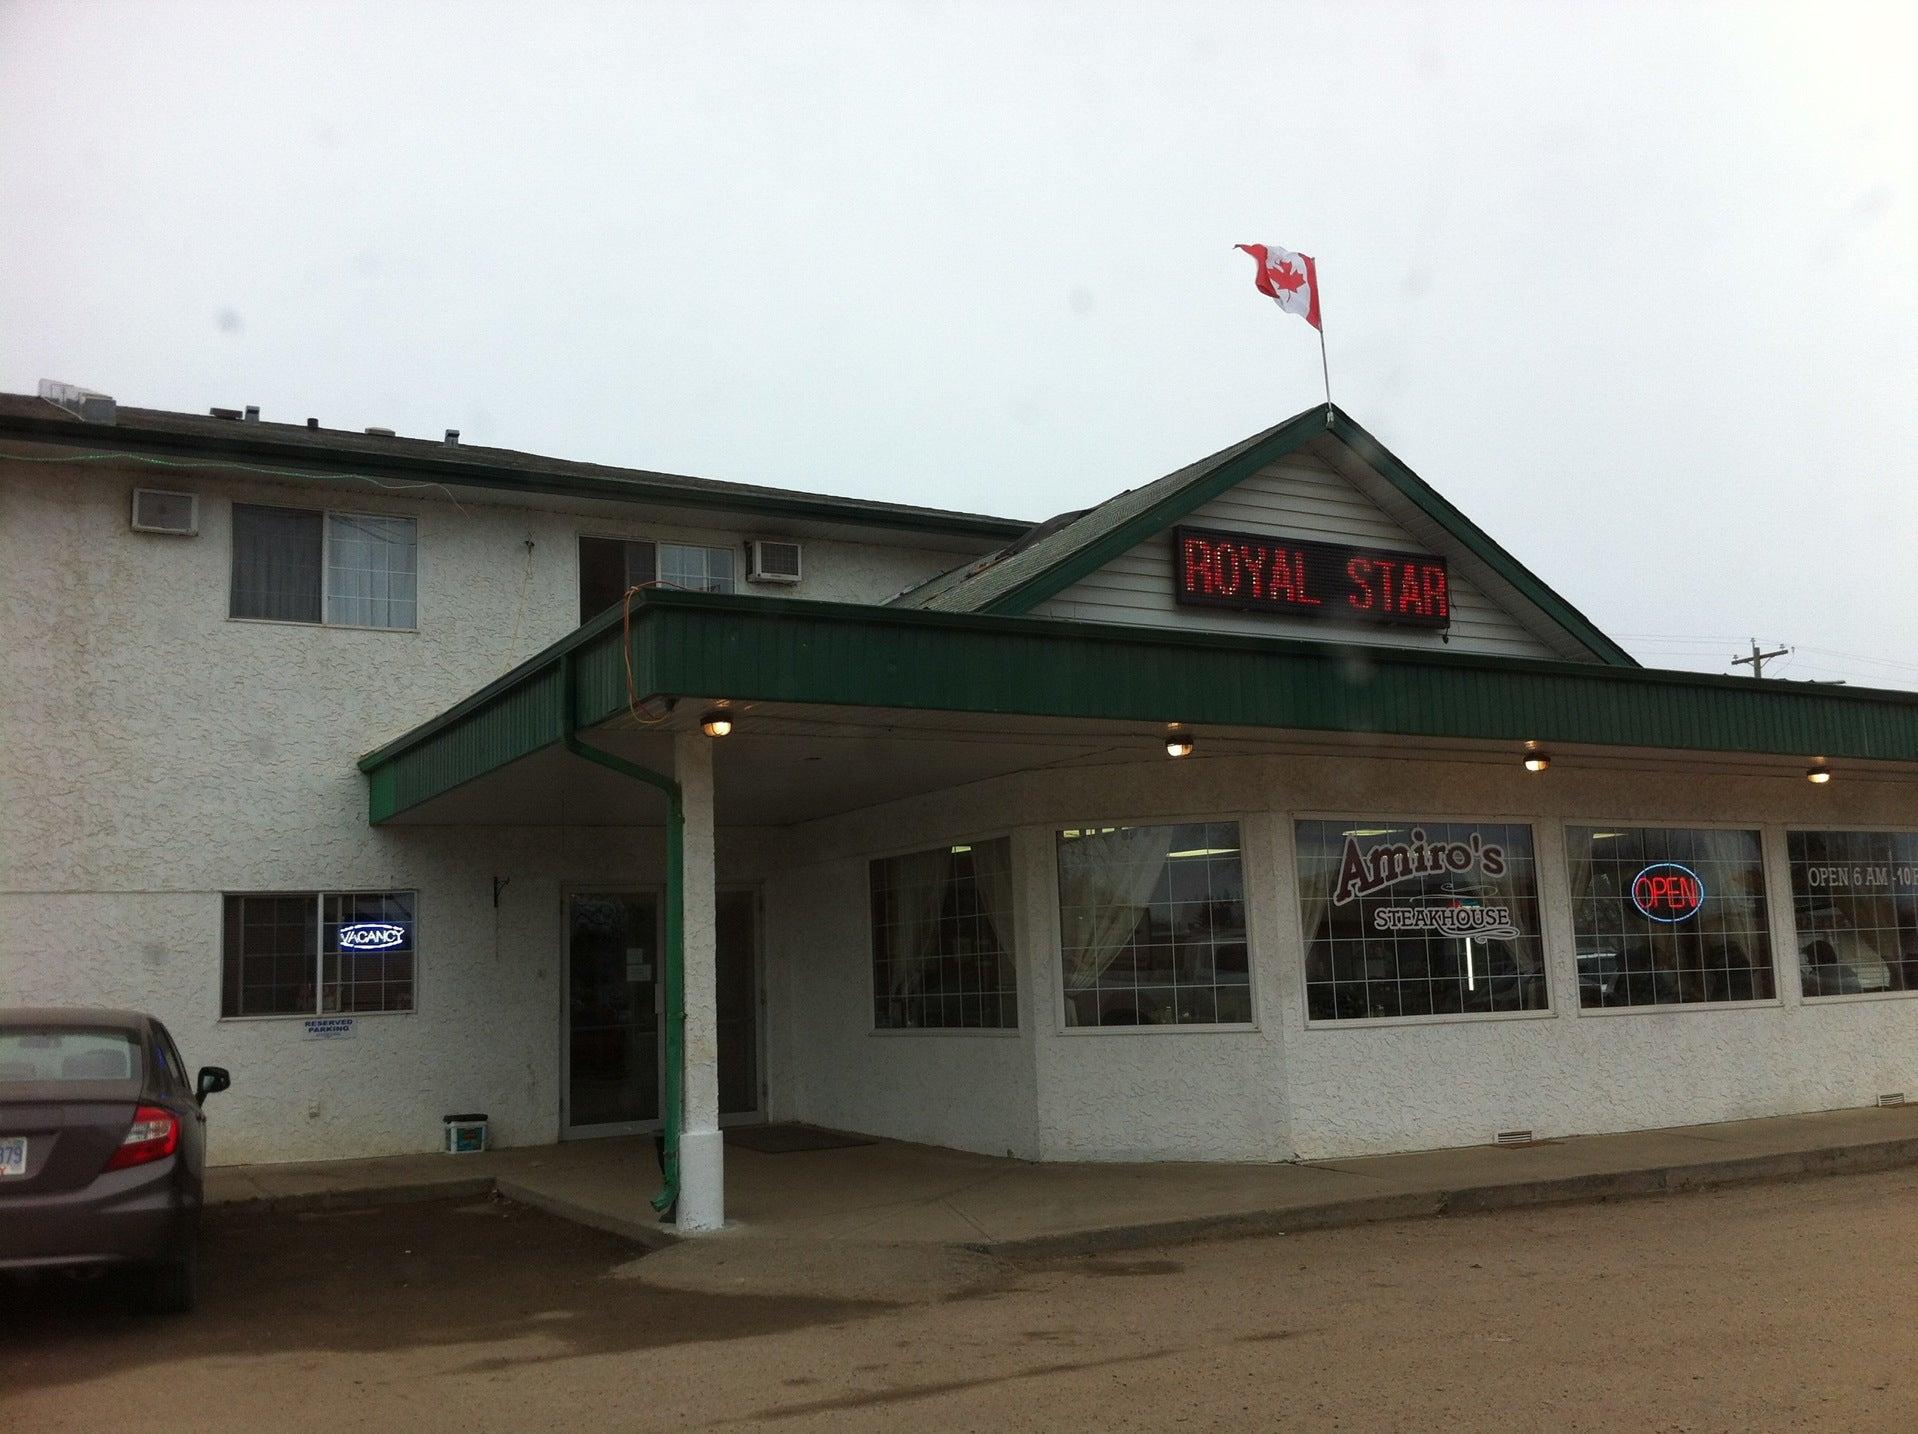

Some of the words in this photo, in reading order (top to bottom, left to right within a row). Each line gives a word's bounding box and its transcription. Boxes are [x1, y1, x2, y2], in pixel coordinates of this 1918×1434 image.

[1184, 538, 1321, 605] ROYAL
[1347, 555, 1448, 616] STAR
[1333, 827, 1506, 907] Amiro's
[1808, 867, 1849, 887] OPEN
[1853, 867, 1862, 887] 6
[1865, 867, 1889, 886] AM
[1634, 876, 1699, 908] OPEN
[1374, 906, 1512, 938] STEAKHOUSE
[340, 929, 405, 944] VACANCY
[304, 1019, 353, 1027] RESERVED
[308, 1025, 350, 1033] PARKING
